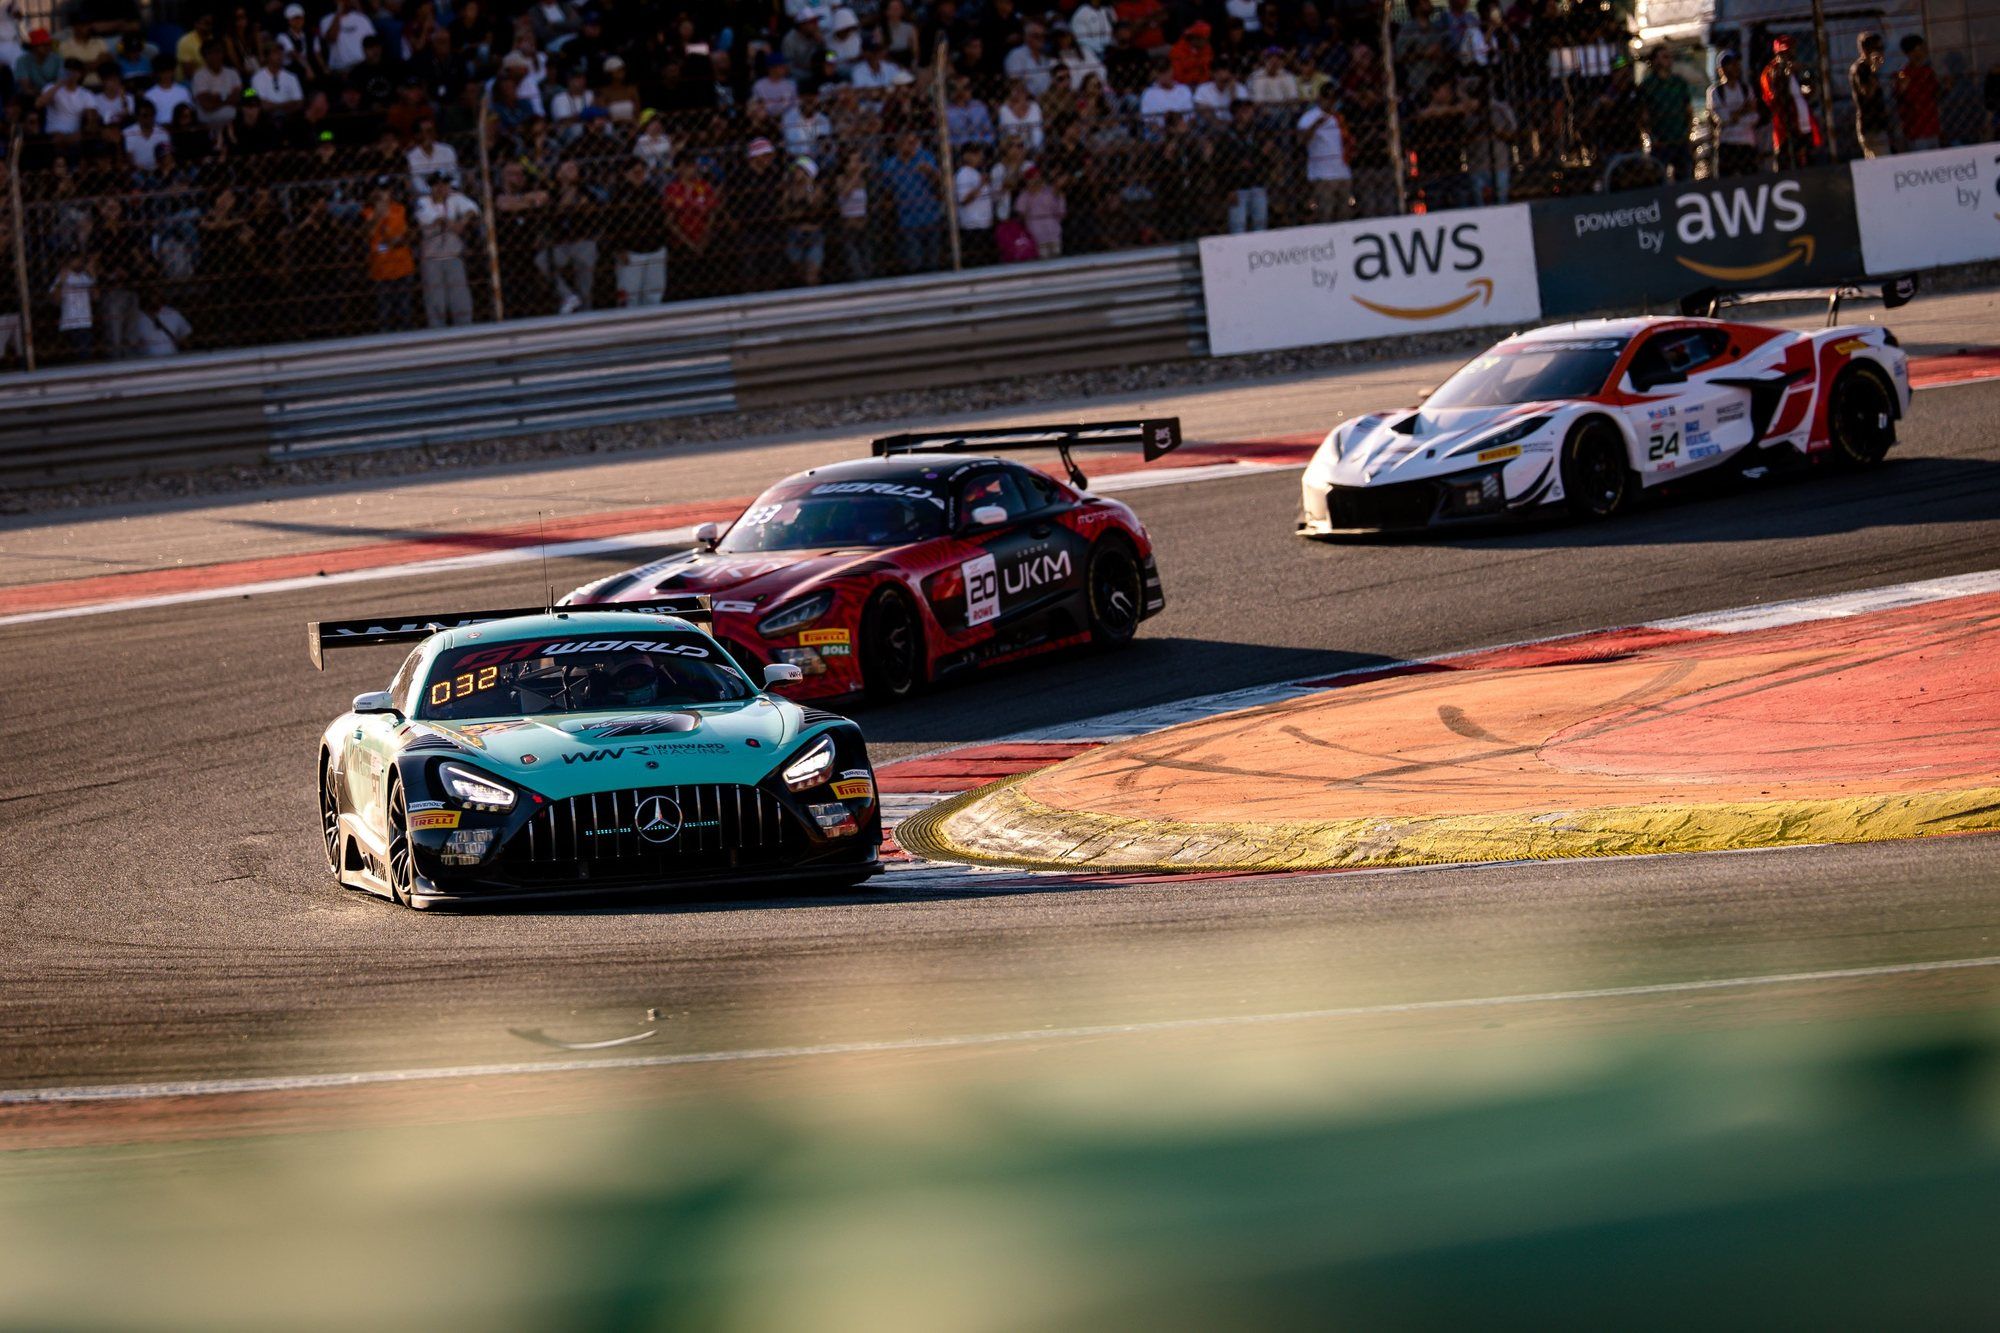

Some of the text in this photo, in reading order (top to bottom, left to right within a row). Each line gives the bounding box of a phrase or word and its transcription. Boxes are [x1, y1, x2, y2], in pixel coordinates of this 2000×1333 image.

[1893, 158, 1977, 192] powered
[1675, 180, 1807, 244] aws
[1956, 184, 1980, 211] by
[1574, 199, 1660, 238] powered
[1352, 222, 1485, 282] aws
[1637, 227, 1664, 253] by
[1248, 240, 1336, 272] powered
[1312, 265, 1338, 292] by
[1649, 431, 1679, 461] 24
[811, 483, 932, 499] WORLD
[1004, 550, 1072, 594] UKM
[970, 570, 997, 605] 20
[973, 604, 993, 621] ROWE
[453, 638, 710, 668] GT WORLD
[821, 645, 850, 655] BOLL
[431, 665, 498, 704] 032
[653, 743, 725, 751] WINWARD
[411, 813, 455, 827] PIRELLI
